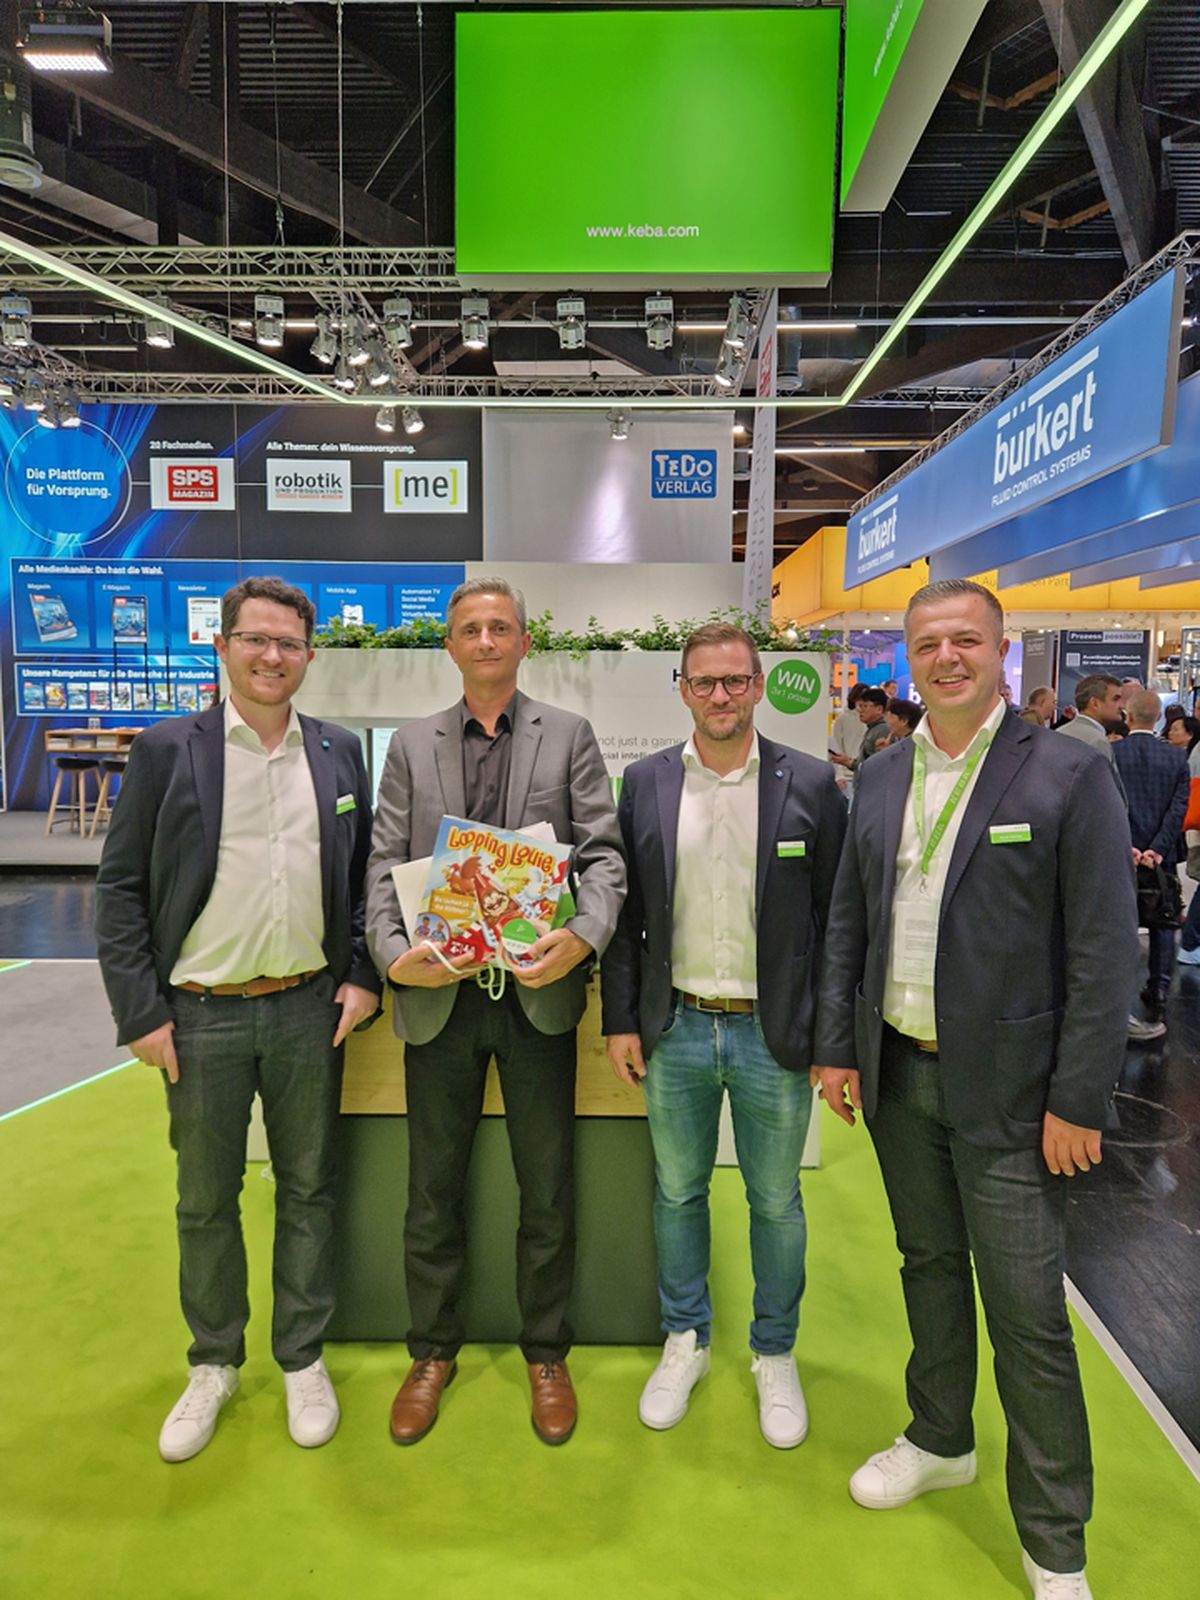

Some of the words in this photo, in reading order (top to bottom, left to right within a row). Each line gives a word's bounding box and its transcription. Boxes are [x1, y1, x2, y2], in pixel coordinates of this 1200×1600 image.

[586, 224, 700, 238] www.keba.com
[162, 440, 214, 450] Fachmedien.
[266, 441, 282, 450] Alle
[283, 442, 319, 452] Themen:
[320, 443, 339, 451] dein
[339, 443, 416, 454] Wissensvorsprung.
[26, 467, 46, 480] Die
[48, 468, 104, 481] Plattform
[172, 468, 214, 487] SPS
[275, 472, 342, 488] robotik
[992, 487, 1011, 508] FLUID
[1012, 469, 1048, 498] CONTROL
[1049, 444, 1092, 479] SYSTEMS
[27, 484, 46, 495] für
[47, 485, 112, 499] Vorsprung.
[172, 490, 214, 498] MAGAZIN
[655, 480, 713, 494] VERLAG
[18, 565, 34, 573] Alle
[35, 565, 94, 574] Medienkanäle:
[95, 566, 107, 574] Du
[108, 566, 126, 574] hast
[127, 566, 140, 574] die
[140, 566, 164, 575] Wahl.
[1071, 632, 1102, 640] Prozess
[22, 668, 50, 677] Unsere
[51, 668, 97, 679] Kompetenz
[778, 668, 816, 694] WIN
[618, 735, 638, 748] just
[641, 737, 648, 746] a
[448, 826, 508, 869] Looping
[509, 842, 555, 874] Louie
